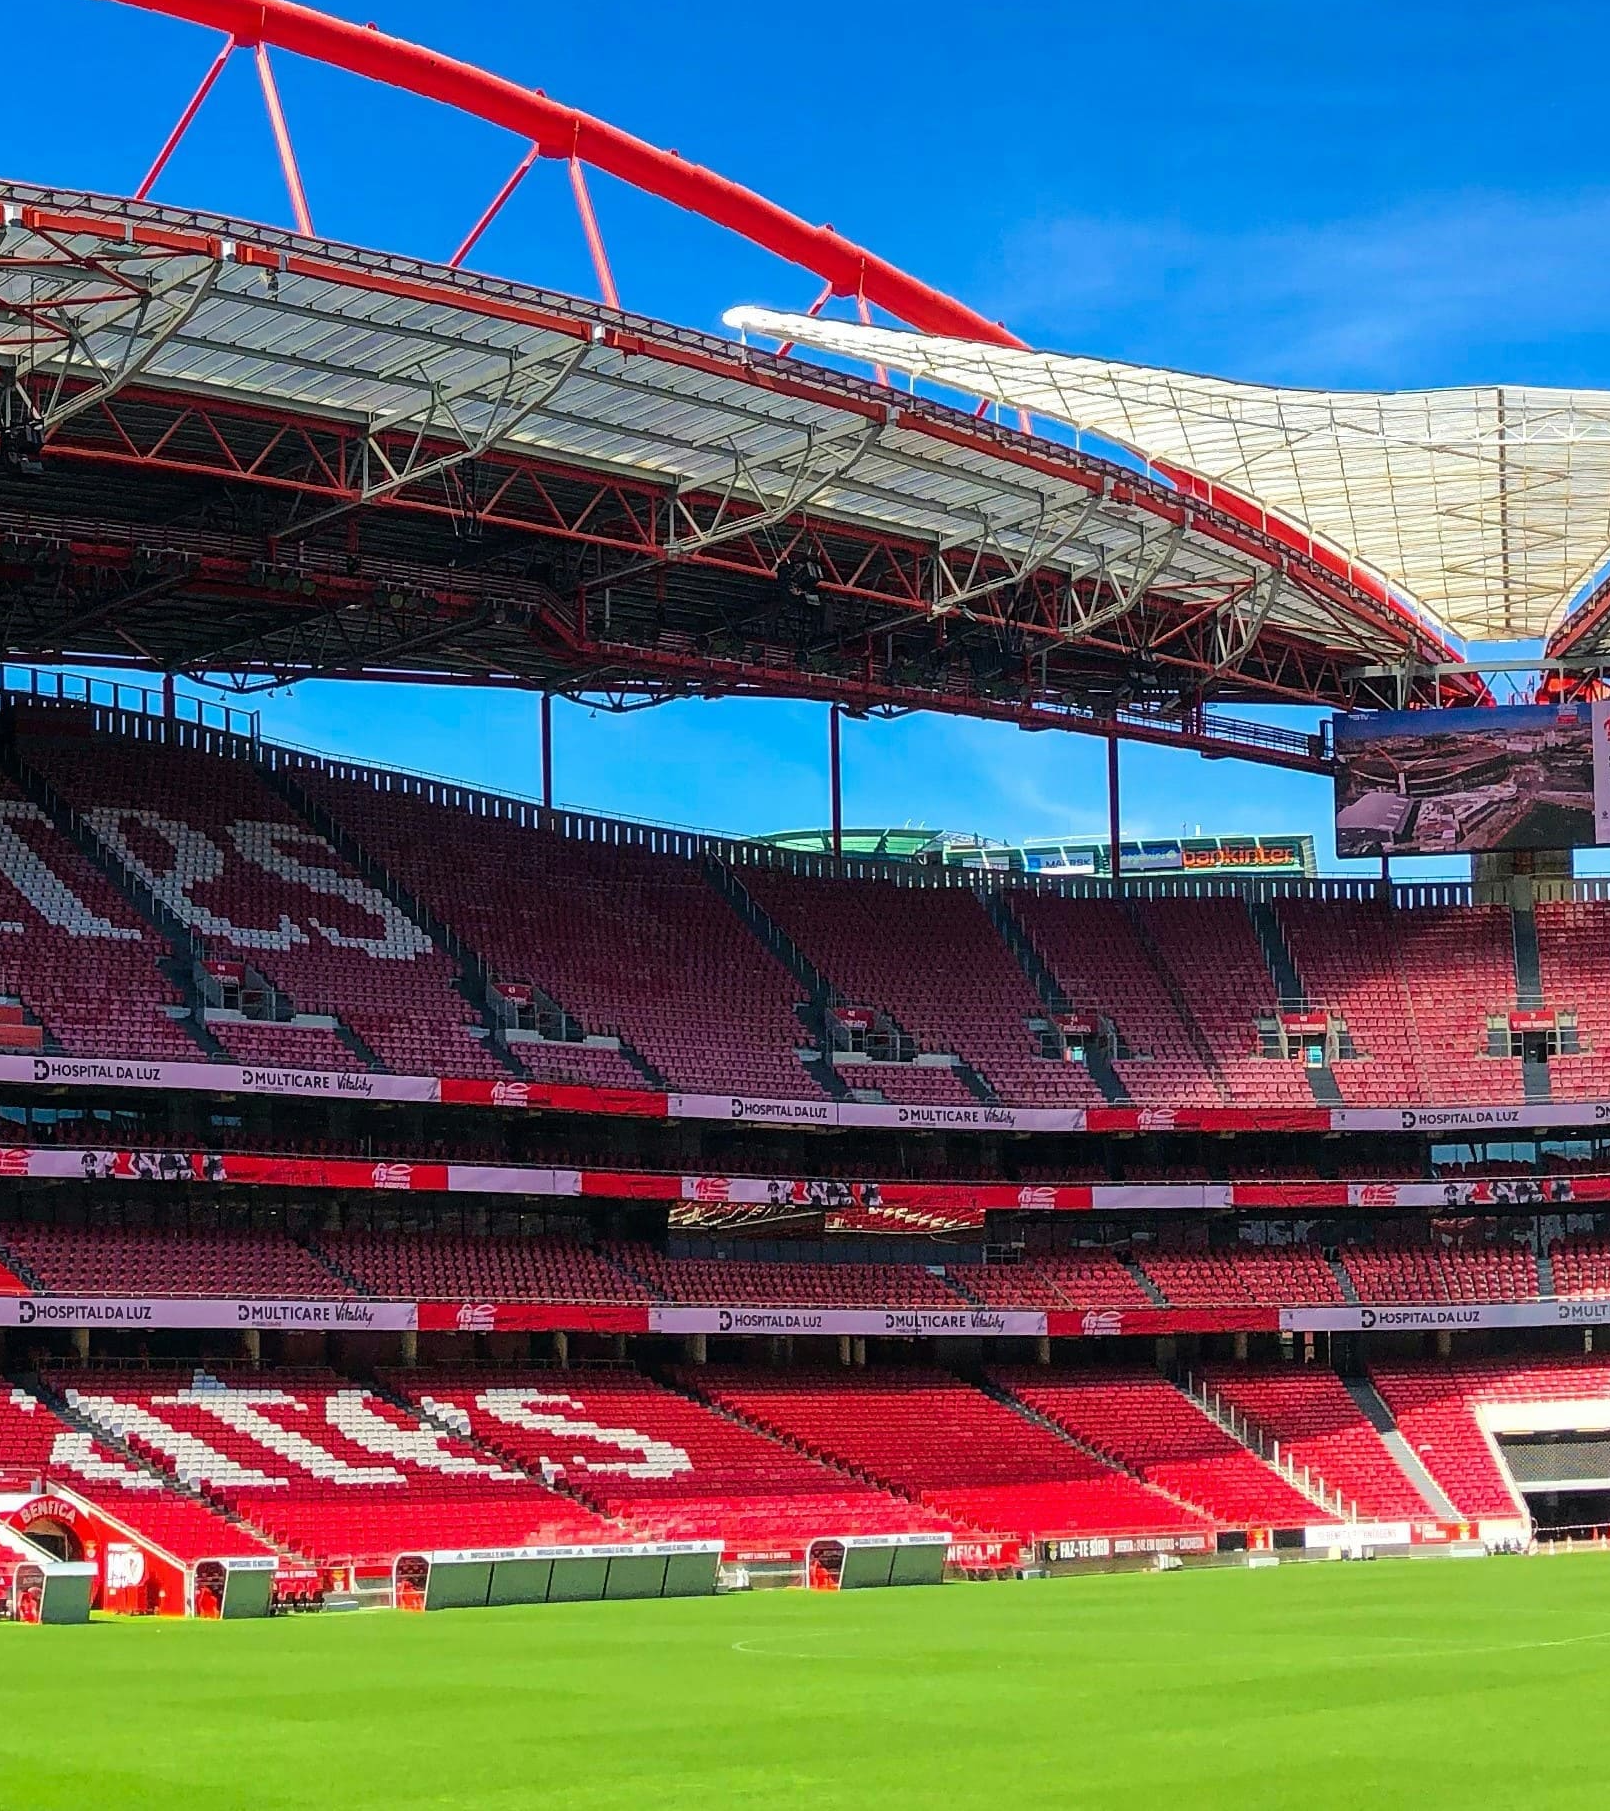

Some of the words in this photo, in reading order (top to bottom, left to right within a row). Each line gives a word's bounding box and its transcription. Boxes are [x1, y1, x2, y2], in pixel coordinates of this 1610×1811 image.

[1183, 846, 1293, 867] bankinter
[52, 1064, 113, 1077] HOSPITAL
[117, 1067, 133, 1079] DA
[137, 1068, 160, 1080] LUZ
[255, 1074, 329, 1090] MULTICARE
[336, 1074, 374, 1097] Vitality
[745, 1104, 793, 1116] HOSPITAL
[795, 1107, 809, 1117] DA
[810, 1107, 827, 1118] LUZ
[911, 1110, 978, 1122] MULTICARE
[1419, 1114, 1475, 1124] HOSPITAL
[1477, 1112, 1493, 1122] DA
[1496, 1111, 1519, 1121] LUZ
[37, 1306, 103, 1319] HOSPITAL
[105, 1307, 123, 1319] DA
[127, 1307, 151, 1319] LUZ
[252, 1307, 329, 1320] MULTICARE
[335, 1304, 374, 1325] Vitality
[1380, 1313, 1436, 1324] HOSPITAL
[1438, 1312, 1454, 1323] DA
[1457, 1311, 1479, 1322] LUZ
[735, 1315, 784, 1327] HOSPITAL
[786, 1316, 800, 1327] DA
[803, 1316, 821, 1327] LUZ
[895, 1315, 966, 1329] MULTICARE
[20, 1501, 76, 1524] BENFICA
[943, 1545, 1002, 1562] NFICA.PT
